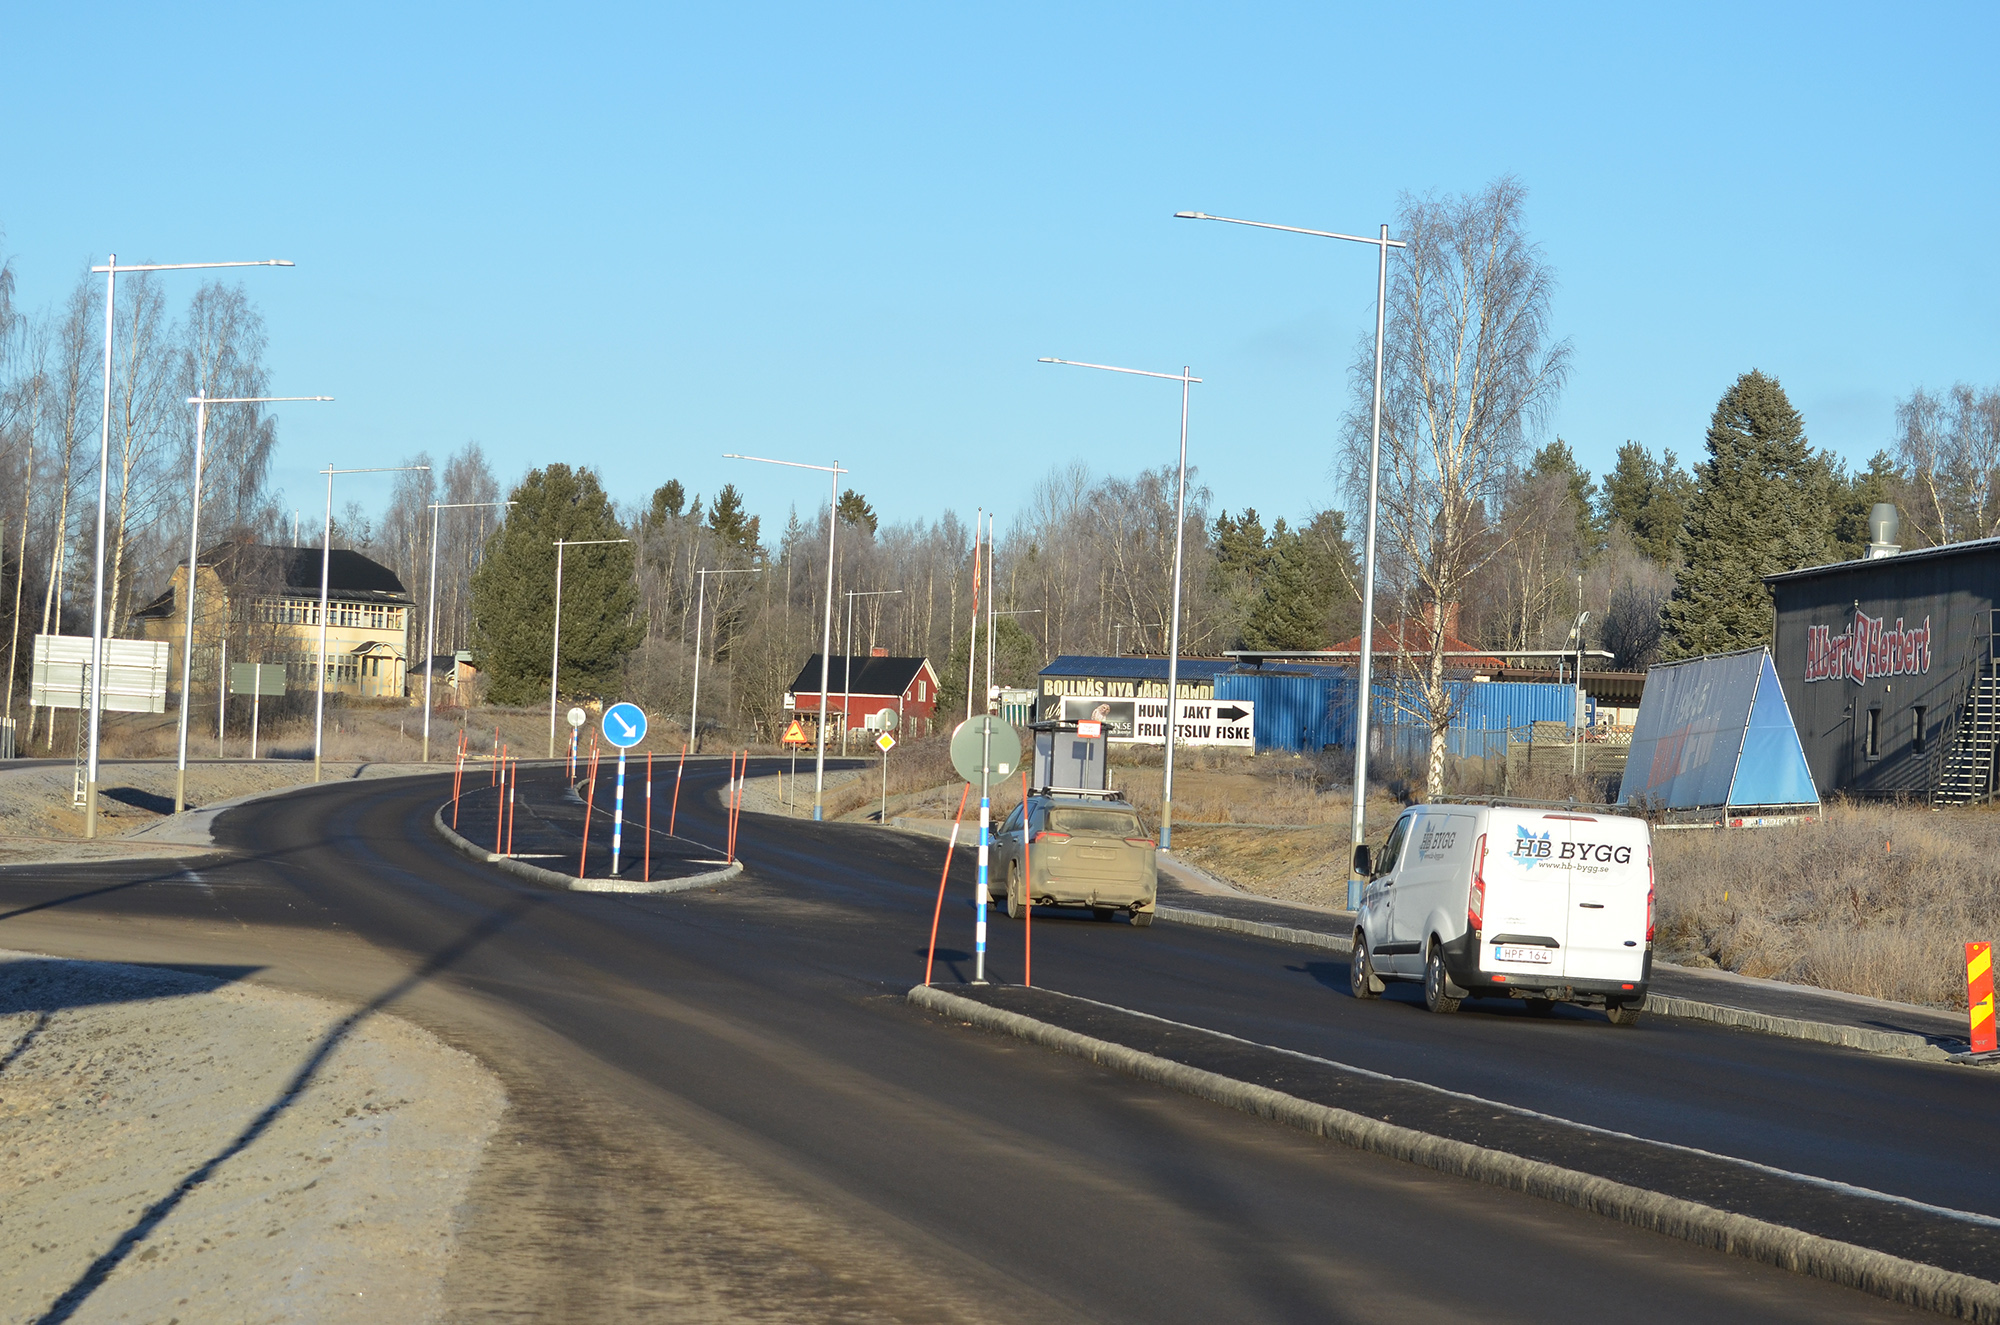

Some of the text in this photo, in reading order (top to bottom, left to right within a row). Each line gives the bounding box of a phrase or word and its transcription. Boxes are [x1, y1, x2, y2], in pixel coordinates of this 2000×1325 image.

[1805, 614, 1931, 682] Albert & Herbert
[1043, 678, 1104, 696] BOLLNÄS
[1107, 681, 1134, 697] NYA
[1183, 705, 1212, 719] JAKT
[1216, 726, 1250, 740] FISKE
[1431, 831, 1457, 850] BYGG
[1513, 839, 1632, 865] HB BYGG
[1538, 861, 1609, 874] www.hb-bygg.se
[1504, 949, 1547, 961] HPF 164
